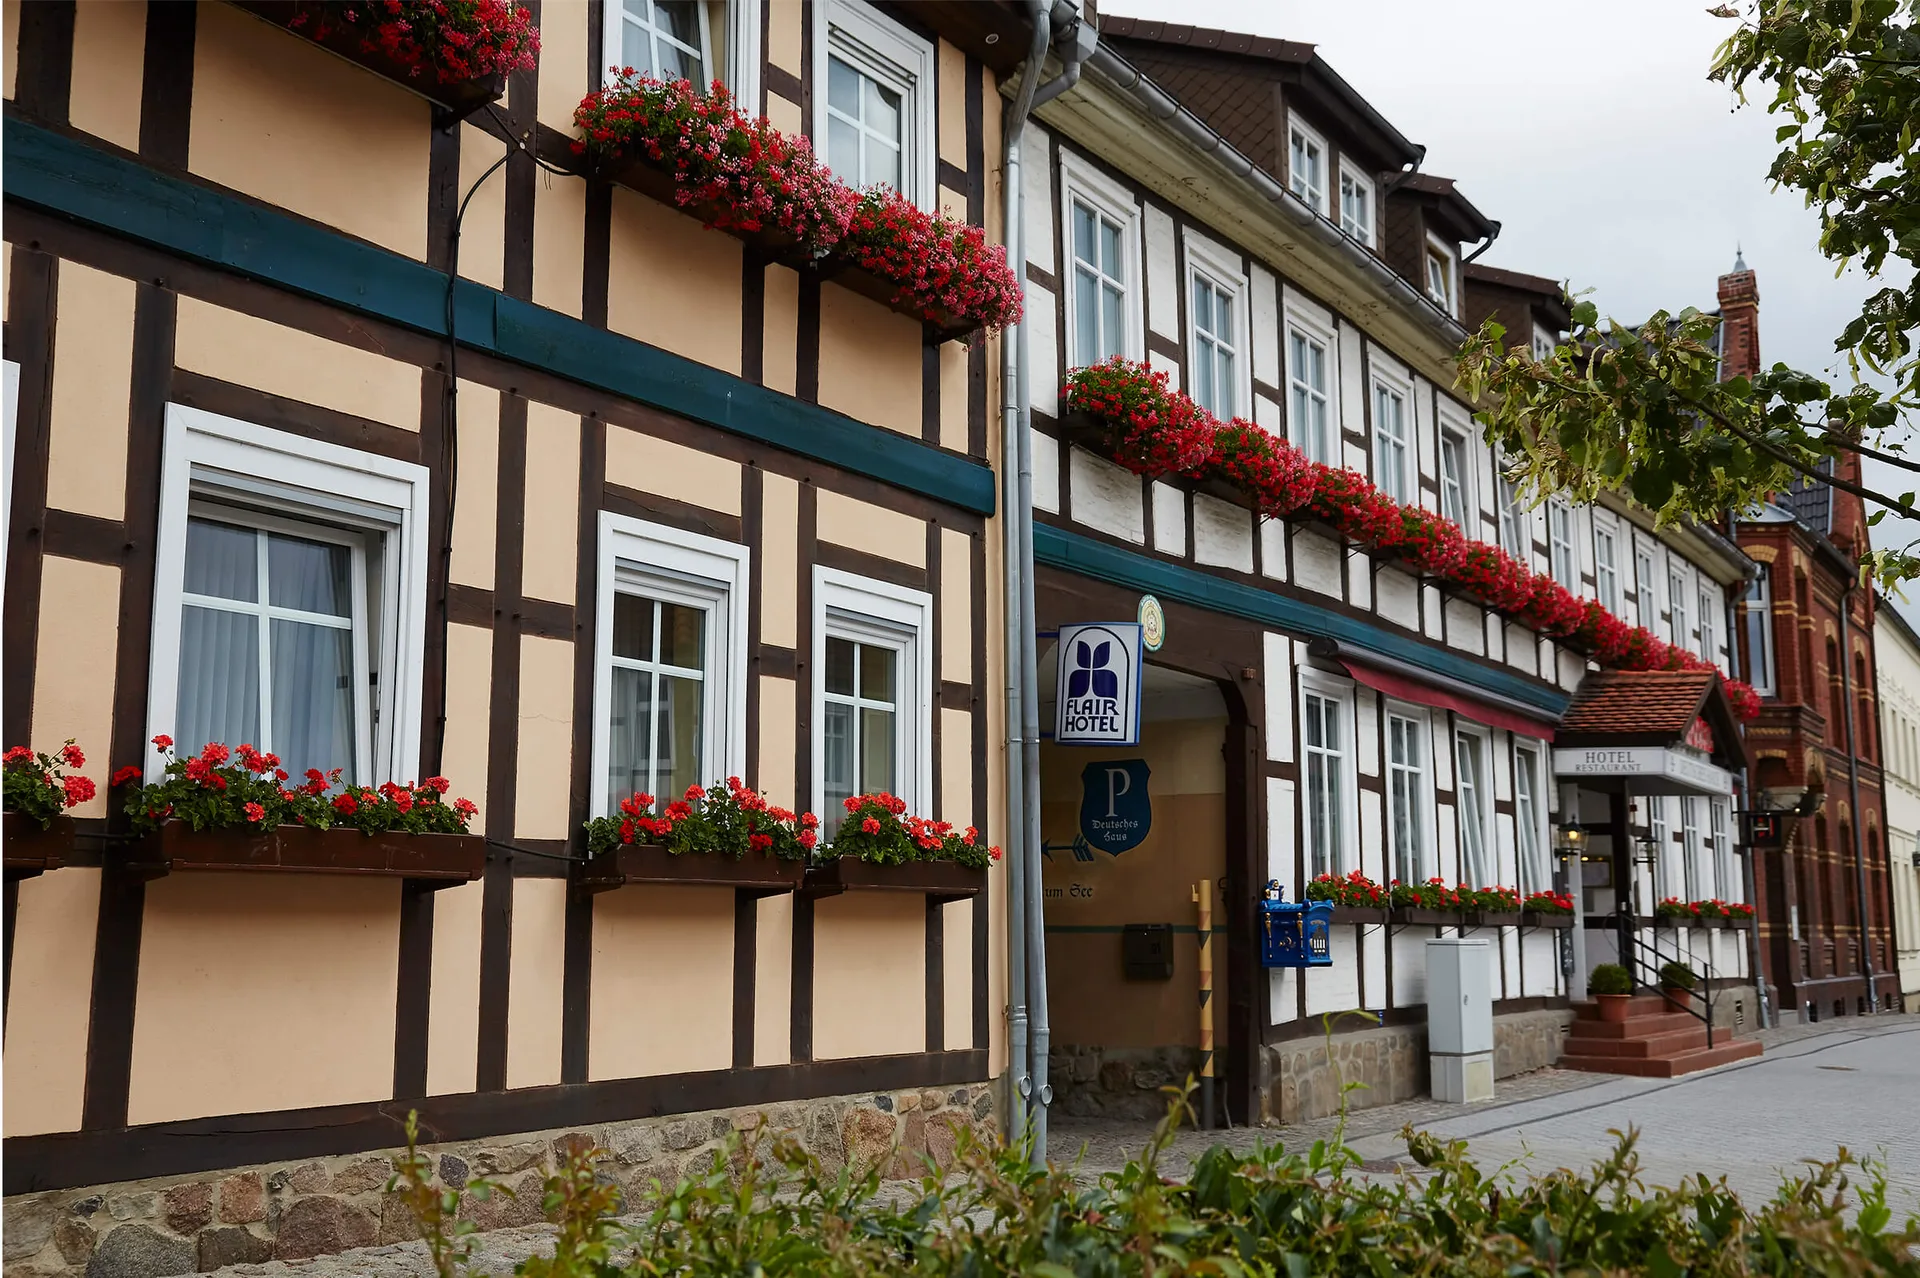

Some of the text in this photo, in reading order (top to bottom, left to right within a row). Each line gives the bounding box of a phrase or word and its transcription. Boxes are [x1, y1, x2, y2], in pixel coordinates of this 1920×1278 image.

[1066, 699, 1120, 715] FLAIR
[1065, 716, 1118, 732] HOTEL
[1585, 751, 1635, 763] HOTEL
[1575, 763, 1641, 771] RESTAURANT
[1104, 768, 1131, 817] P
[1091, 819, 1139, 831] Deutsches
[1103, 831, 1127, 842] Haus
[1045, 883, 1093, 898] um See
